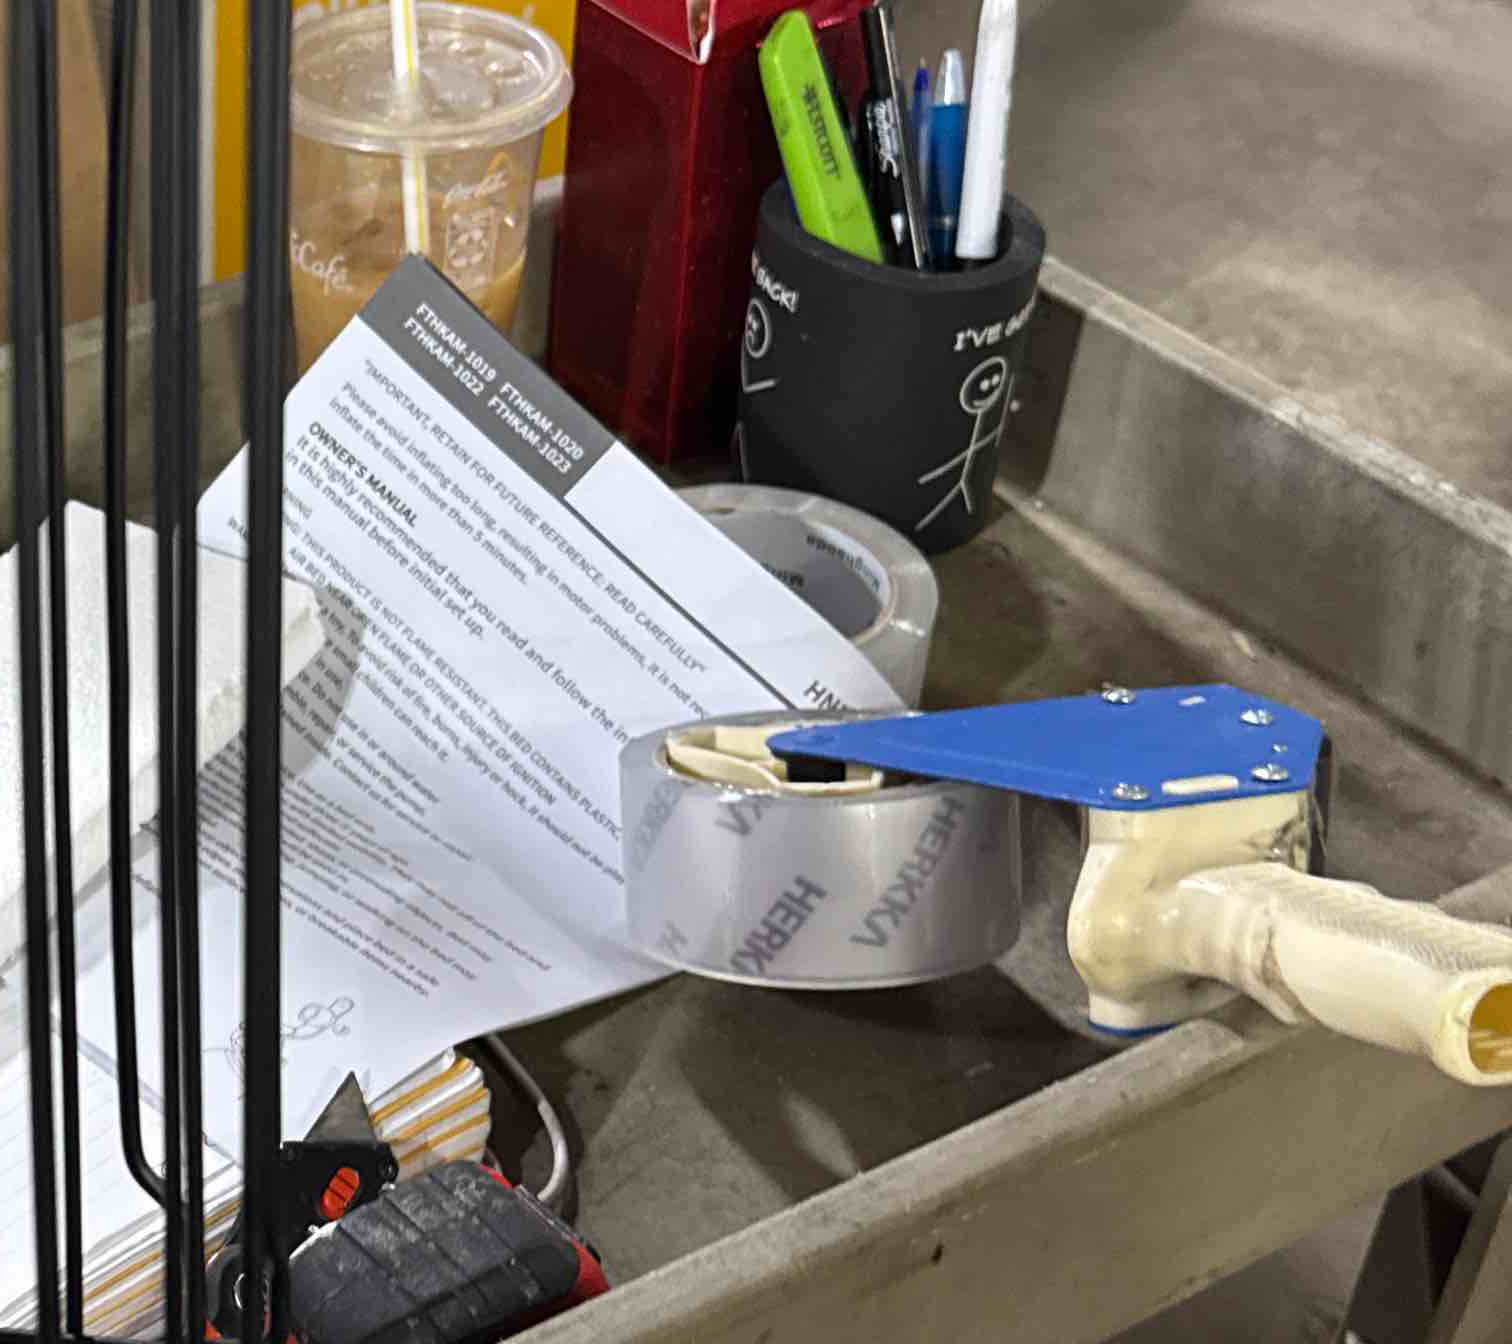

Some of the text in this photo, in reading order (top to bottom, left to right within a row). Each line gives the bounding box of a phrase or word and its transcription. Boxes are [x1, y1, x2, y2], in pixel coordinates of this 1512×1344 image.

[402, 316, 572, 474] FTHKAM-1022 FTHKAM-1023
[414, 302, 585, 461] FTHKAM-1019 FTHKAM-1020
[281, 450, 300, 468] in
[296, 458, 329, 490] this
[319, 479, 373, 530] manual
[366, 524, 412, 568] before
[407, 562, 447, 601] initial
[442, 593, 470, 620] set
[306, 420, 368, 479] OWNER'S
[364, 474, 420, 526] MANUAL
[295, 435, 616, 731] It is highly recommended that you read and follow the
